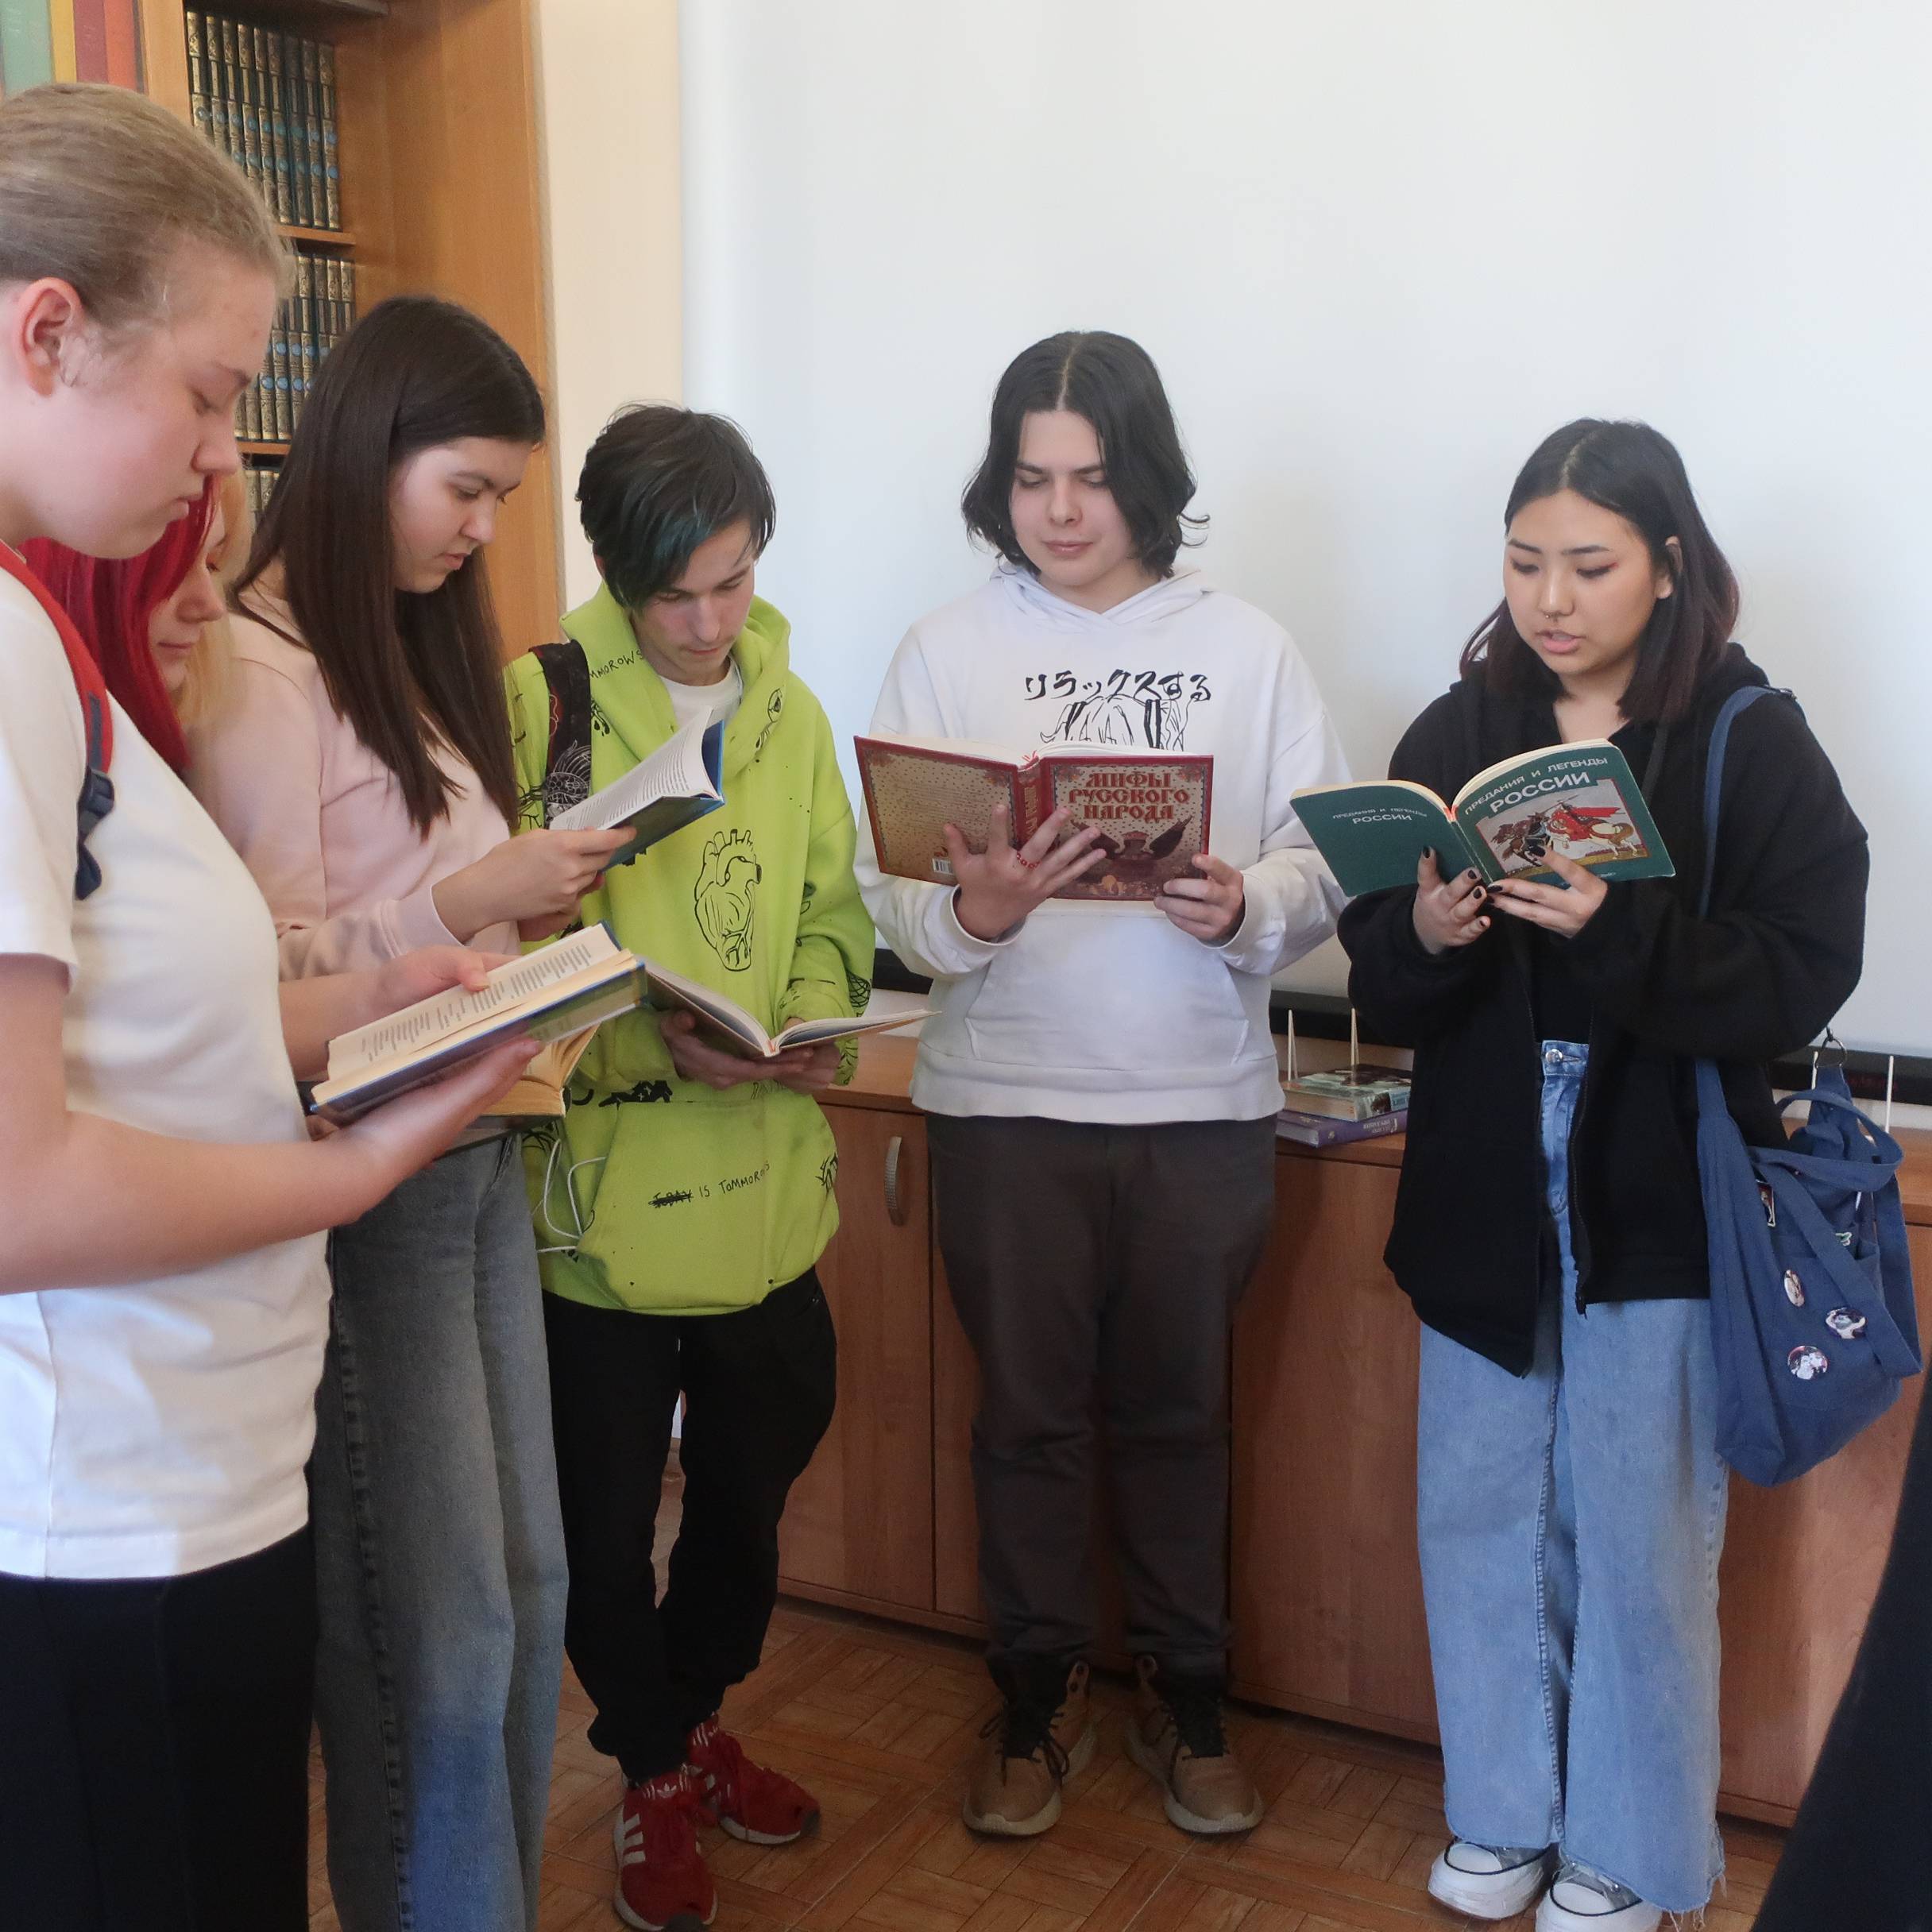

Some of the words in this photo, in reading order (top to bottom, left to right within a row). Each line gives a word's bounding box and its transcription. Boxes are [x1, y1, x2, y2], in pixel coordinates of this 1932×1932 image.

[1025, 669, 1211, 701] リラックスする
[1085, 771, 1172, 788] МИФЫ
[1464, 775, 1526, 815] ПРЕДАНИЯ
[1548, 757, 1609, 773] ЛЕГЕНДЫ
[1068, 788, 1190, 804] РУССКОГО
[1490, 771, 1590, 813] РОССИИ
[1084, 804, 1175, 824] НАРОДА
[1352, 813, 1412, 824] РОССИИ
[698, 1184, 710, 1198] IS
